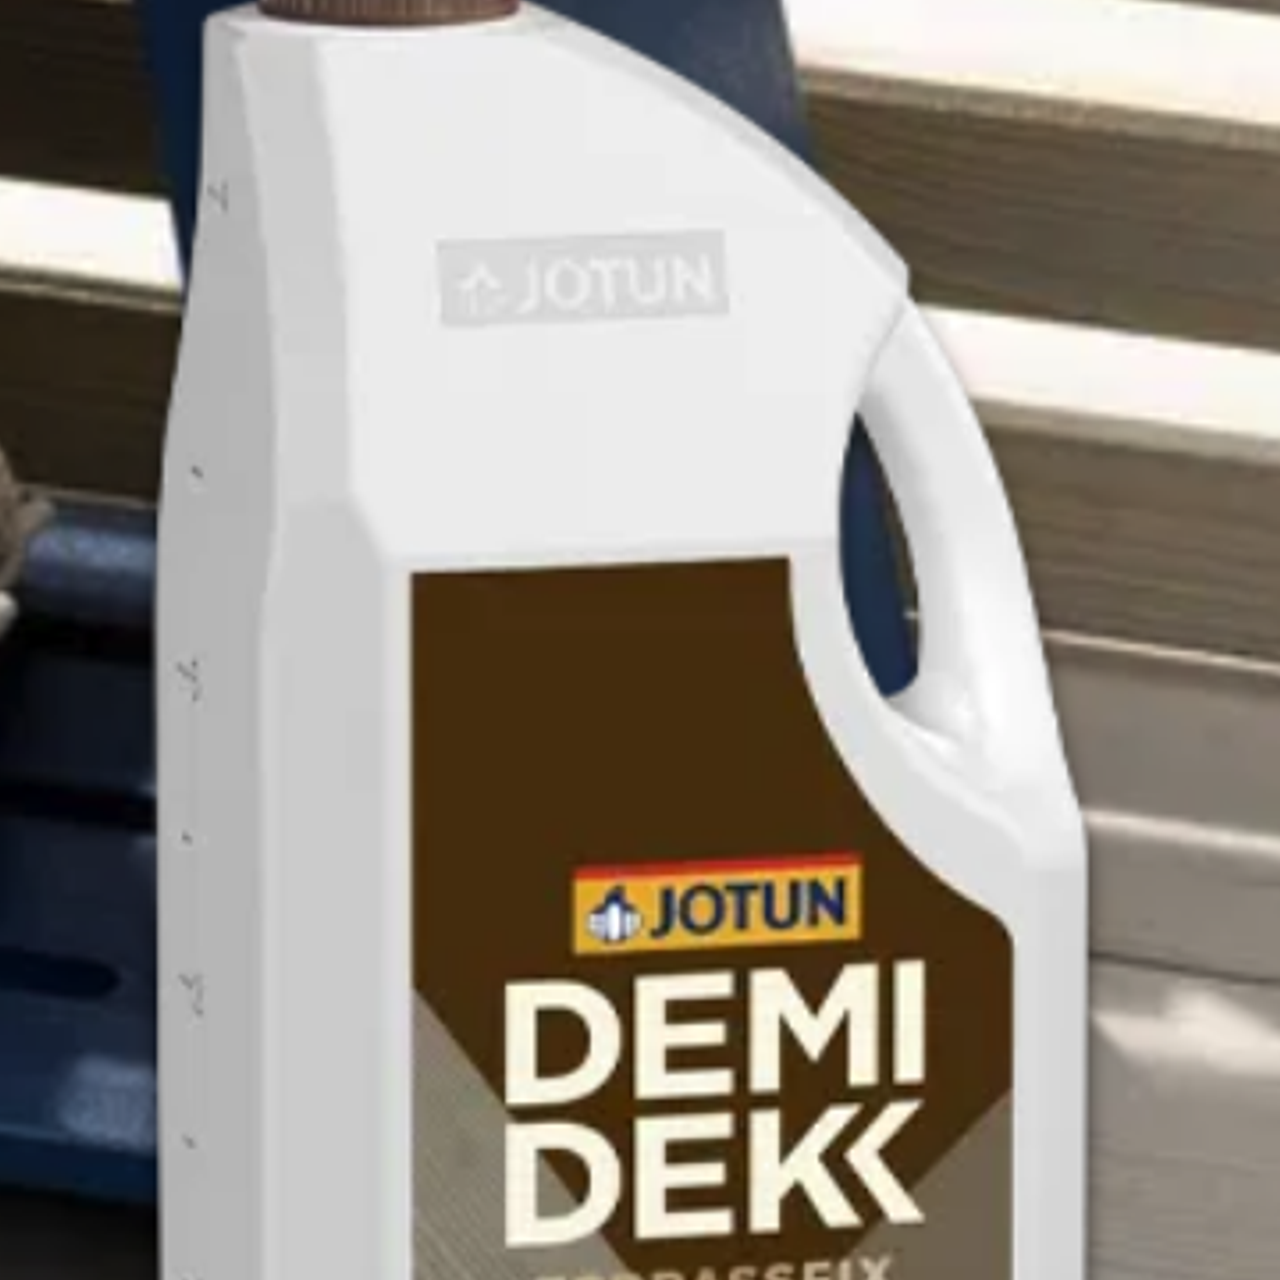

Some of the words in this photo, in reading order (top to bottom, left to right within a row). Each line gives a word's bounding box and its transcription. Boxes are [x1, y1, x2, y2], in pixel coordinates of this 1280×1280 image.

[515, 252, 714, 315] JOTUN
[649, 876, 847, 939] JOTUN
[504, 958, 926, 1108] DEMI
[504, 1098, 926, 1248] DEKK
